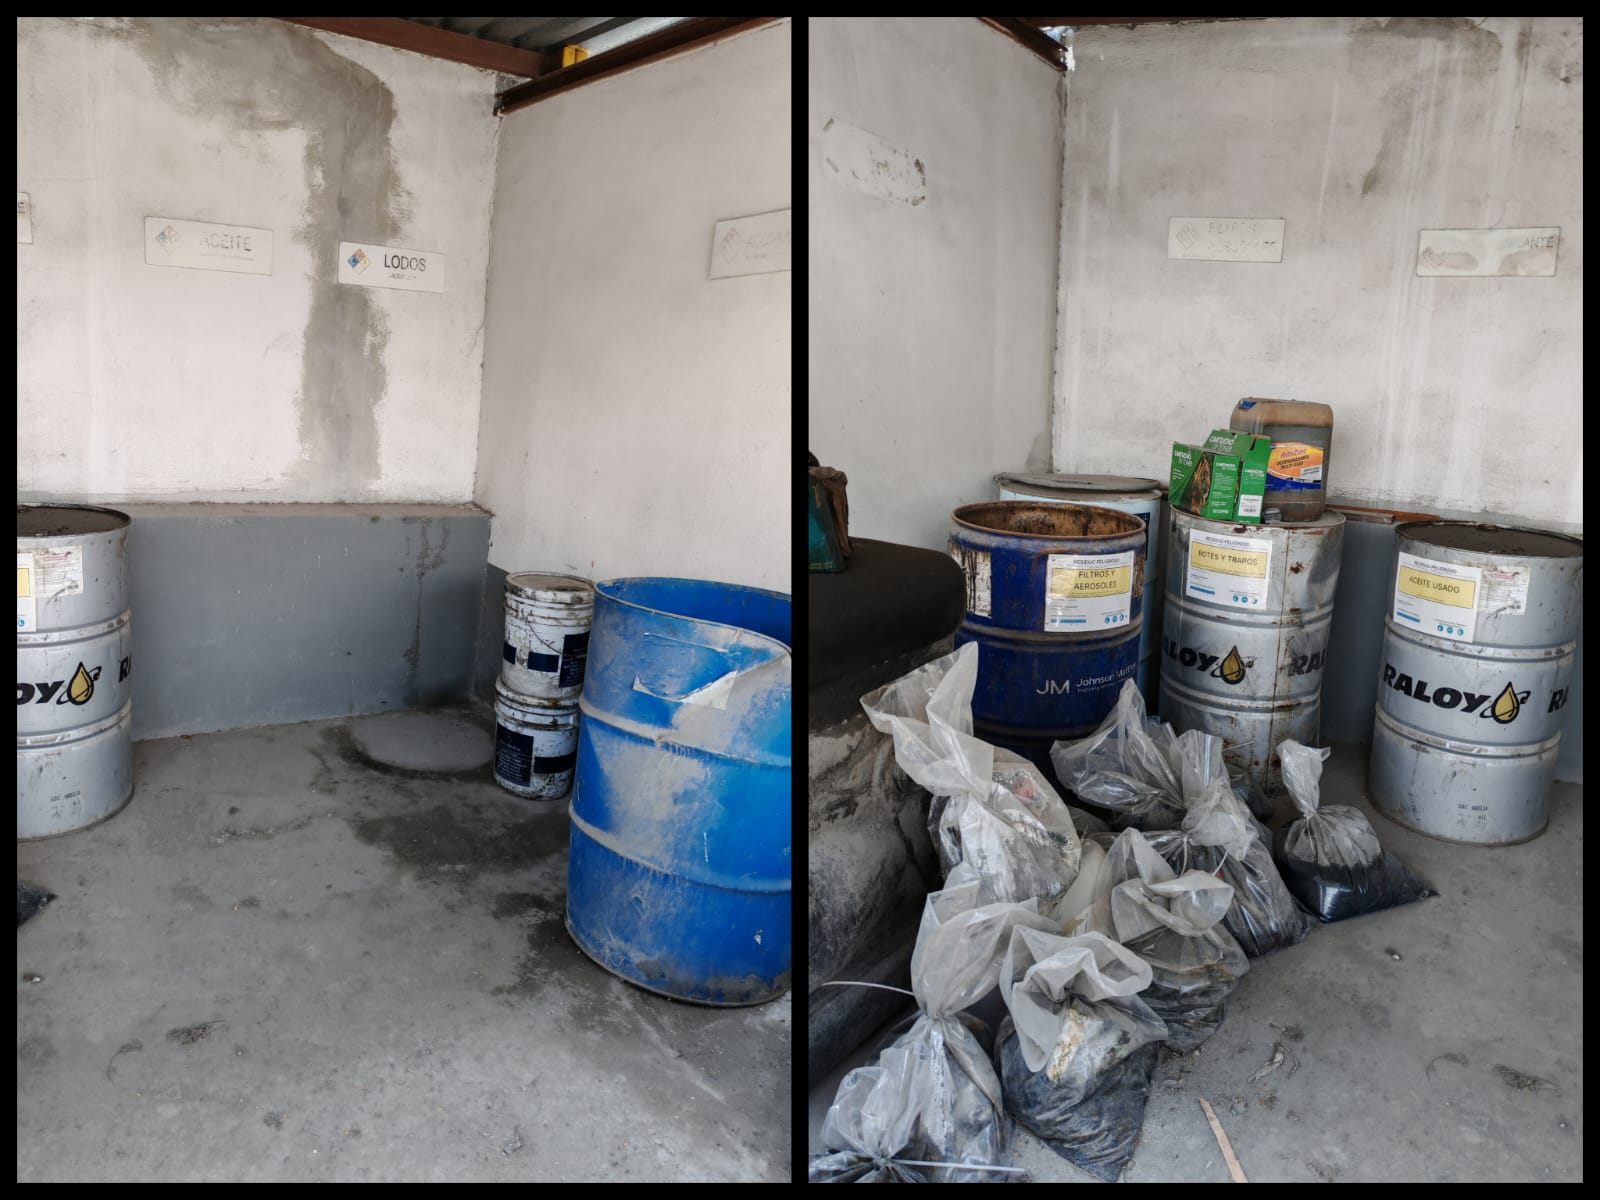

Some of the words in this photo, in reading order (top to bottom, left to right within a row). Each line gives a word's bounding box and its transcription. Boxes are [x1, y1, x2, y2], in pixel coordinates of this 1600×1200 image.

[384, 253, 426, 272] LODOS
[1198, 549, 1219, 561] BOTES
[1228, 555, 1258, 566] TRAPOS
[1078, 570, 1109, 579] FILTROS
[1073, 580, 1118, 591] AEROSOLES
[1408, 575, 1431, 588] ACEITE
[1432, 581, 1461, 594] USADO
[1036, 679, 1070, 695] JM
[1076, 673, 1115, 687] Johnson
[1383, 662, 1491, 714] RALOY
